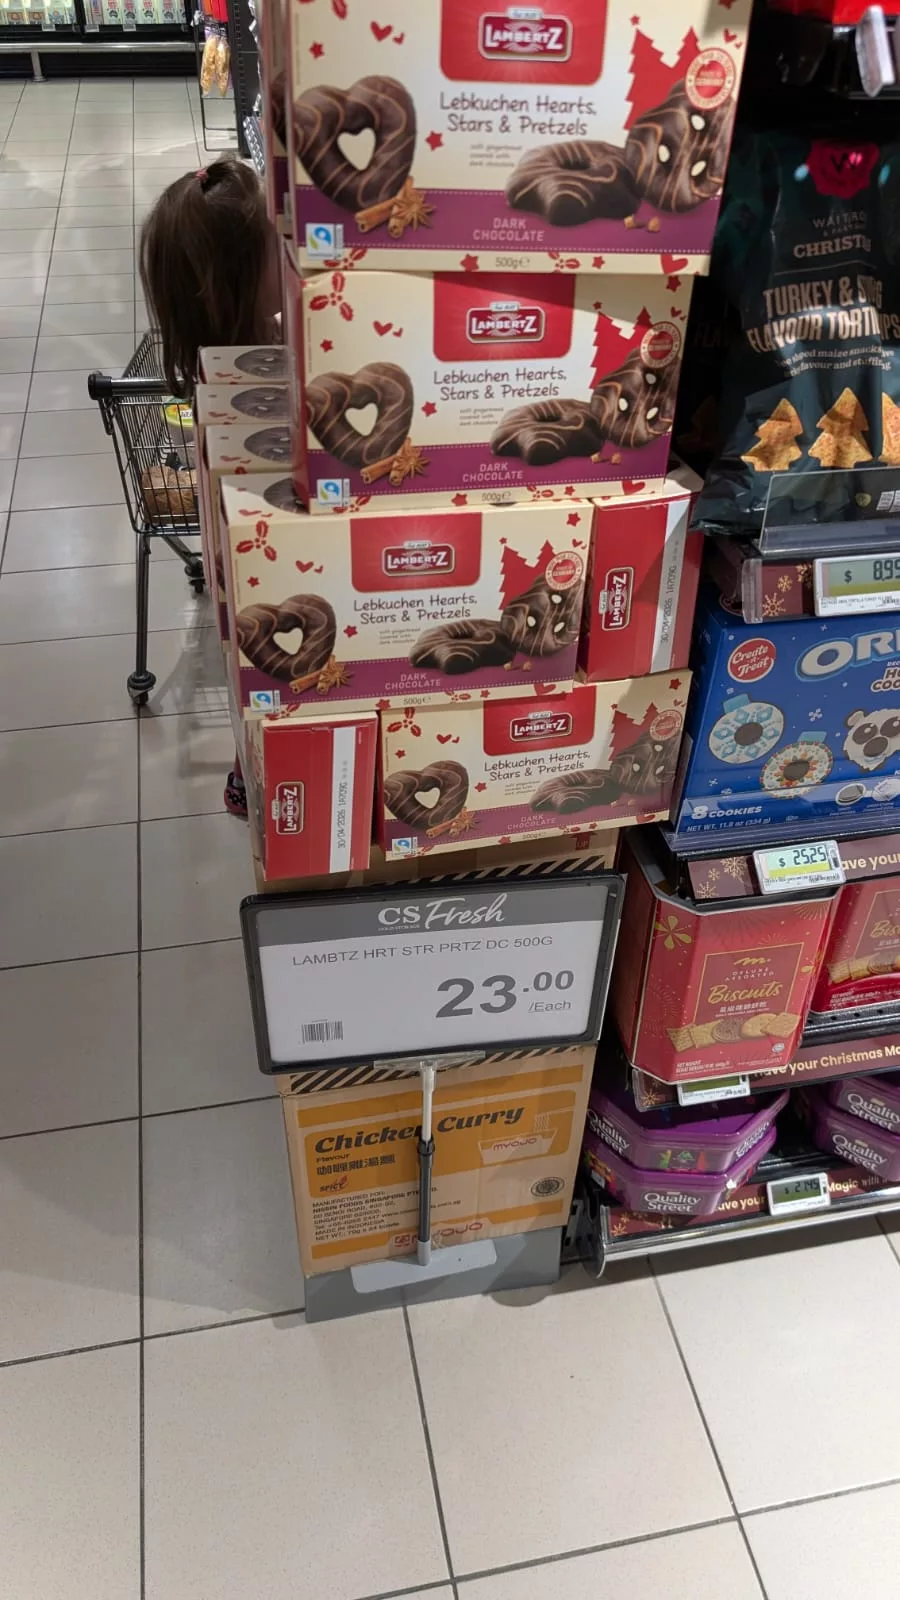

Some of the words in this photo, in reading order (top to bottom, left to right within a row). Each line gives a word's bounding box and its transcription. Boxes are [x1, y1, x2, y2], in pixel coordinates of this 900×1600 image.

[485, 24, 564, 50] LAMBERTZ
[439, 92, 529, 112] Lebkuchen
[448, 114, 493, 133] Stars
[498, 115, 511, 133] &
[520, 118, 588, 136] Pretzels
[493, 217, 526, 229] DARK
[472, 229, 545, 242] CHOCOLATE
[793, 234, 871, 258] CHRIST
[763, 280, 833, 318] TURKEY
[838, 276, 854, 307] &
[471, 316, 538, 335] LAMBERTZ
[746, 313, 824, 353] FLAVOUR
[834, 360, 852, 370] and
[434, 370, 510, 385] Lebkuchen
[440, 386, 479, 401] Stars
[484, 386, 495, 399] &
[502, 383, 560, 399] Pretzels
[462, 470, 524, 482] CHOCOLATE
[479, 462, 508, 472] DARK
[388, 552, 449, 568] LAMBERTZ
[844, 570, 852, 584] $
[354, 598, 424, 612] Lebkuchen
[609, 573, 628, 627] LAMBERTZ
[360, 611, 397, 624] Stars
[401, 609, 411, 622] &
[418, 606, 471, 620] Pretzels
[732, 645, 769, 665] Create
[800, 629, 900, 676] OR
[738, 656, 770, 678] Treat
[384, 678, 442, 691] CHOCOLATE
[400, 672, 427, 682] DARK
[514, 718, 566, 736] LAMBERTZ
[484, 756, 544, 772] Lebkuchen
[490, 770, 521, 782] Stars
[524, 768, 533, 778] &
[538, 761, 585, 775] Pretzels
[283, 786, 298, 832] LAMBERTZ
[691, 805, 709, 820] 8
[708, 806, 763, 818] COOKIES
[507, 818, 557, 830] CHOCOLATE
[521, 814, 544, 823] DARK
[336, 808, 346, 849] 30/04/2026
[778, 857, 786, 868] $
[793, 846, 827, 866] 25.25
[841, 858, 867, 871] ave
[378, 906, 420, 925] CS
[425, 893, 508, 929] Fresh
[292, 950, 359, 966] LAMBTZ
[364, 948, 397, 959] HRT
[402, 944, 434, 956] STR
[439, 940, 481, 952] PRTZ
[486, 939, 509, 950] DC
[514, 936, 553, 948] 500G
[725, 971, 775, 982] ASSORTED
[732, 967, 769, 976] DELUXE
[708, 980, 784, 1004] Biscuits
[528, 1000, 572, 1012] /Each
[789, 1060, 818, 1076] your
[820, 1049, 882, 1067] Christmas
[848, 1093, 900, 1124] Quality
[848, 1104, 894, 1131] Street
[437, 1106, 524, 1132] Curry
[586, 1108, 630, 1150] Quality
[493, 1138, 538, 1151] MYOJO
[589, 1120, 626, 1157] Street
[832, 1134, 888, 1164] Quality
[834, 1145, 878, 1170] Street
[316, 1154, 350, 1163] Flavour
[827, 1178, 858, 1192] Magic
[861, 1175, 880, 1186] with
[312, 1193, 369, 1208] MANUFACTURED
[338, 1200, 364, 1209] FOODS
[364, 1194, 405, 1204] SINGAPORE
[644, 1192, 702, 1206] Quality
[648, 1202, 693, 1212] Street
[718, 1200, 738, 1211] ave
[740, 1196, 766, 1210] your
[316, 1228, 336, 1236] MADE
[346, 1219, 385, 1230] INDONESIA
